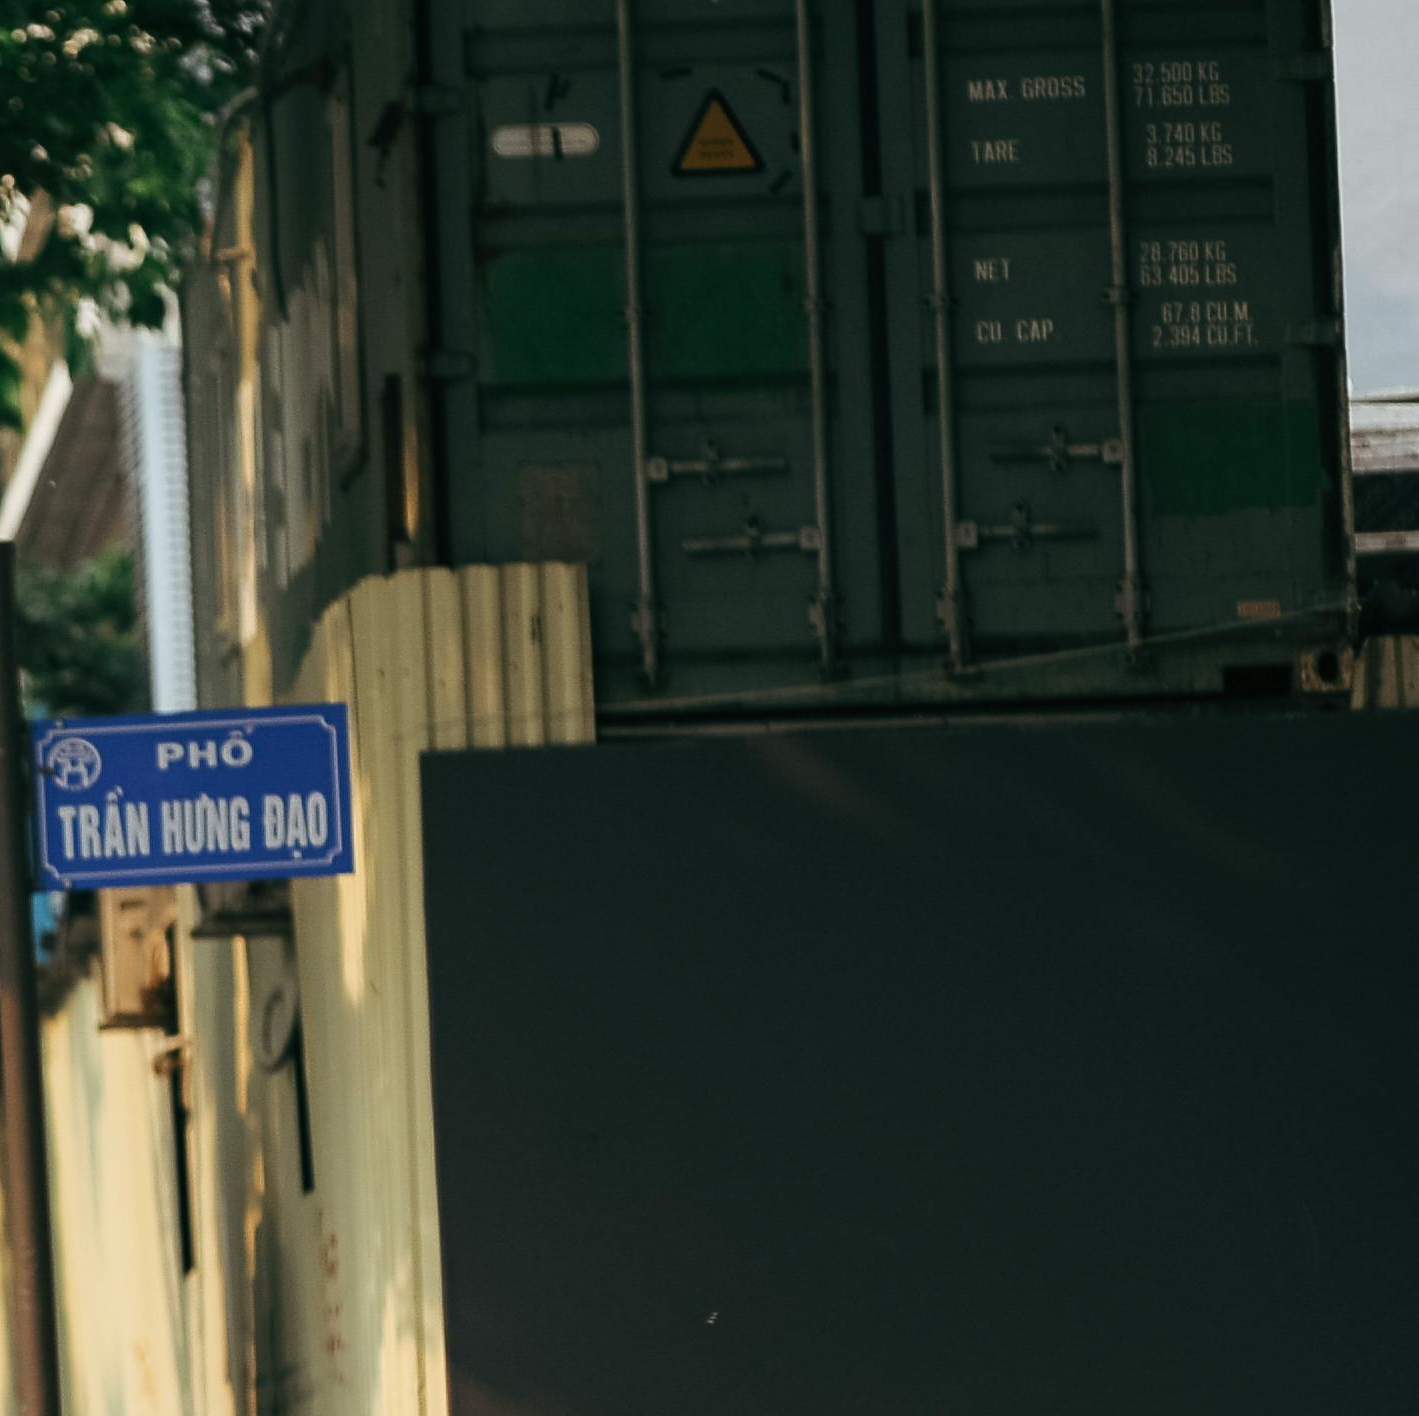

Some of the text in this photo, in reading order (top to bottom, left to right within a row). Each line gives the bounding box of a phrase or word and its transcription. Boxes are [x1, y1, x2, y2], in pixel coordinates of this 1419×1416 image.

[1198, 60, 1220, 82] KG
[968, 75, 1085, 103] MAX GROSS
[1199, 84, 1231, 106] LBS
[1201, 121, 1222, 142] KG
[971, 139, 1020, 164] TARE
[1202, 144, 1233, 166] LBS
[1205, 240, 1226, 261] KG
[976, 257, 1010, 282] NET
[1205, 263, 1237, 285] LBS
[156, 723, 255, 770] PHỐ
[57, 785, 329, 860] TRẦN HƯNG ĐẠO
